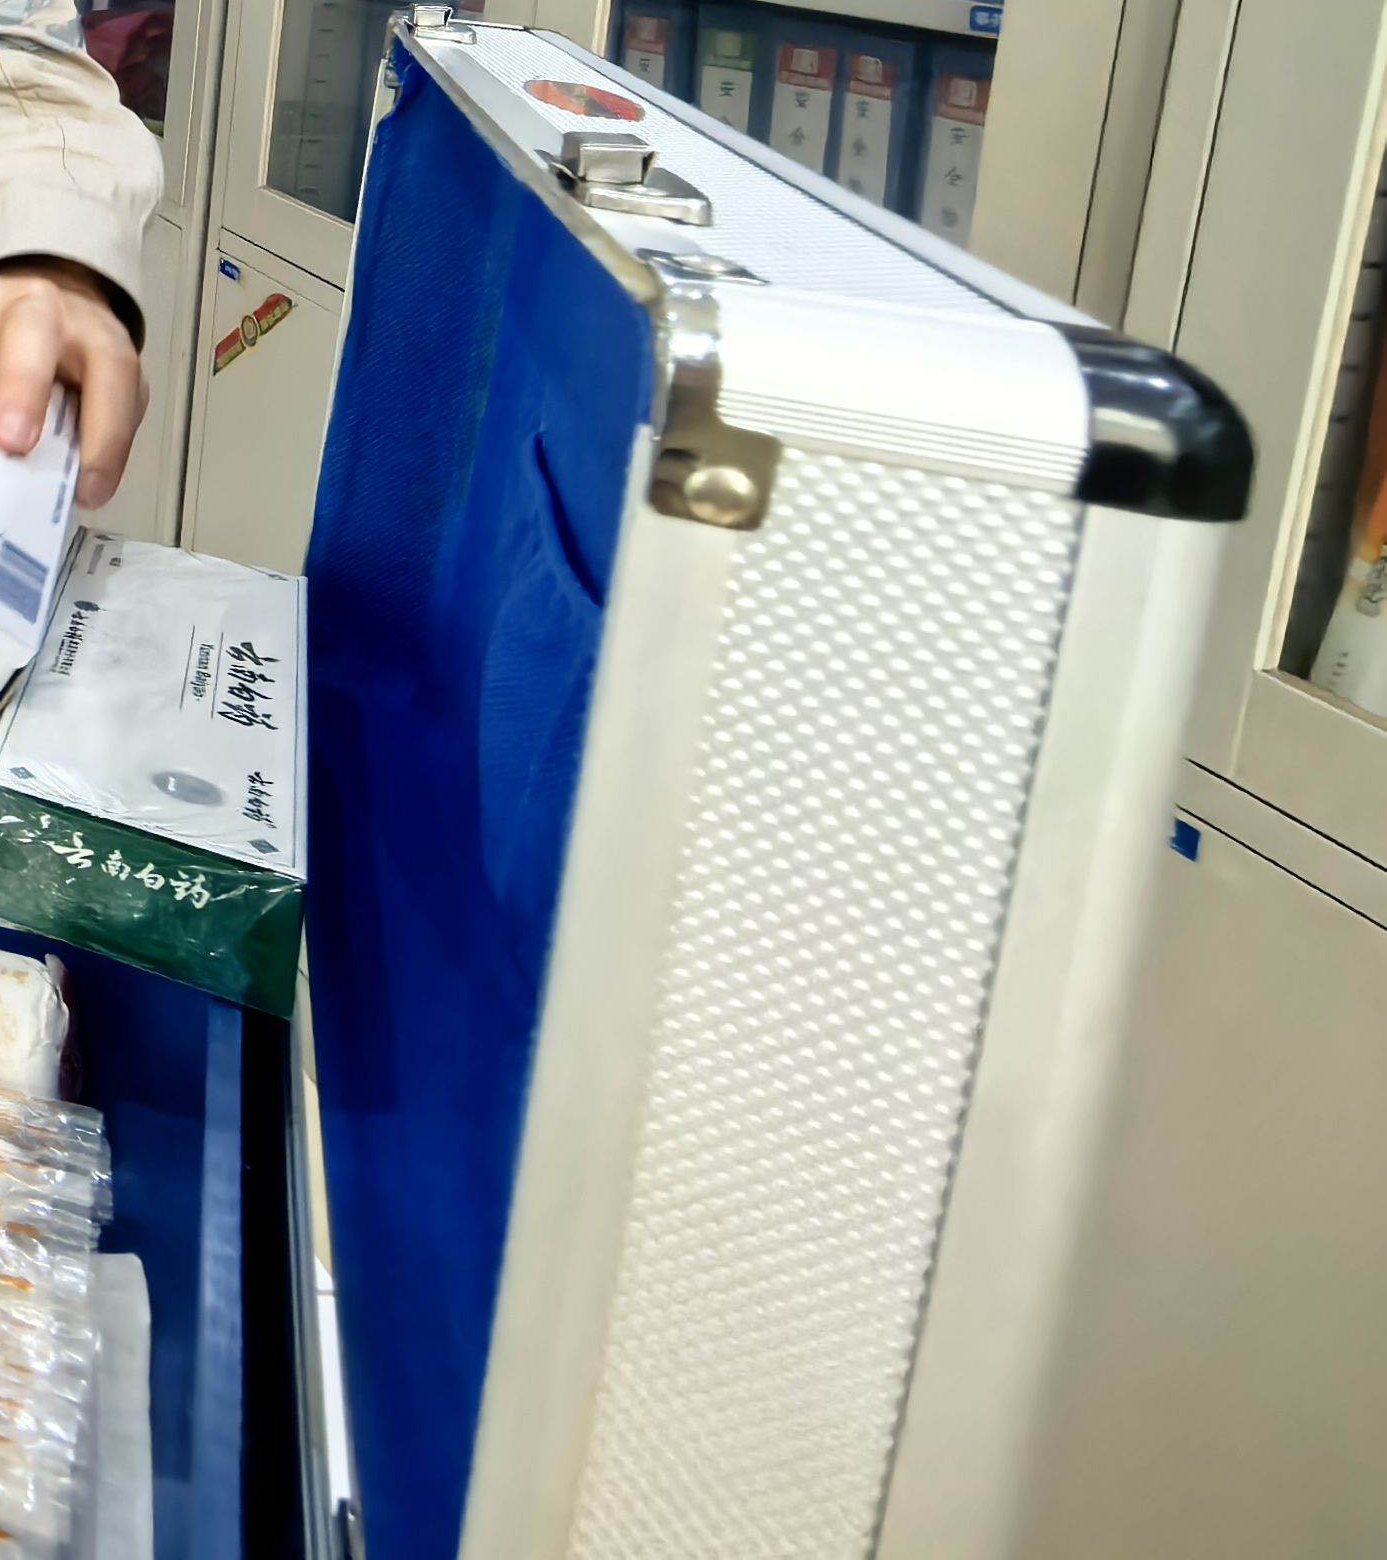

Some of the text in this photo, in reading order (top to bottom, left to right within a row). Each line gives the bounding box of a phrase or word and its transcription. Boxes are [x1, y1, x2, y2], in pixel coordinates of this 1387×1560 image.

[217, 641, 280, 730] 云南白药
[243, 771, 273, 823] 云南白药
[43, 831, 213, 910] 云南白药
